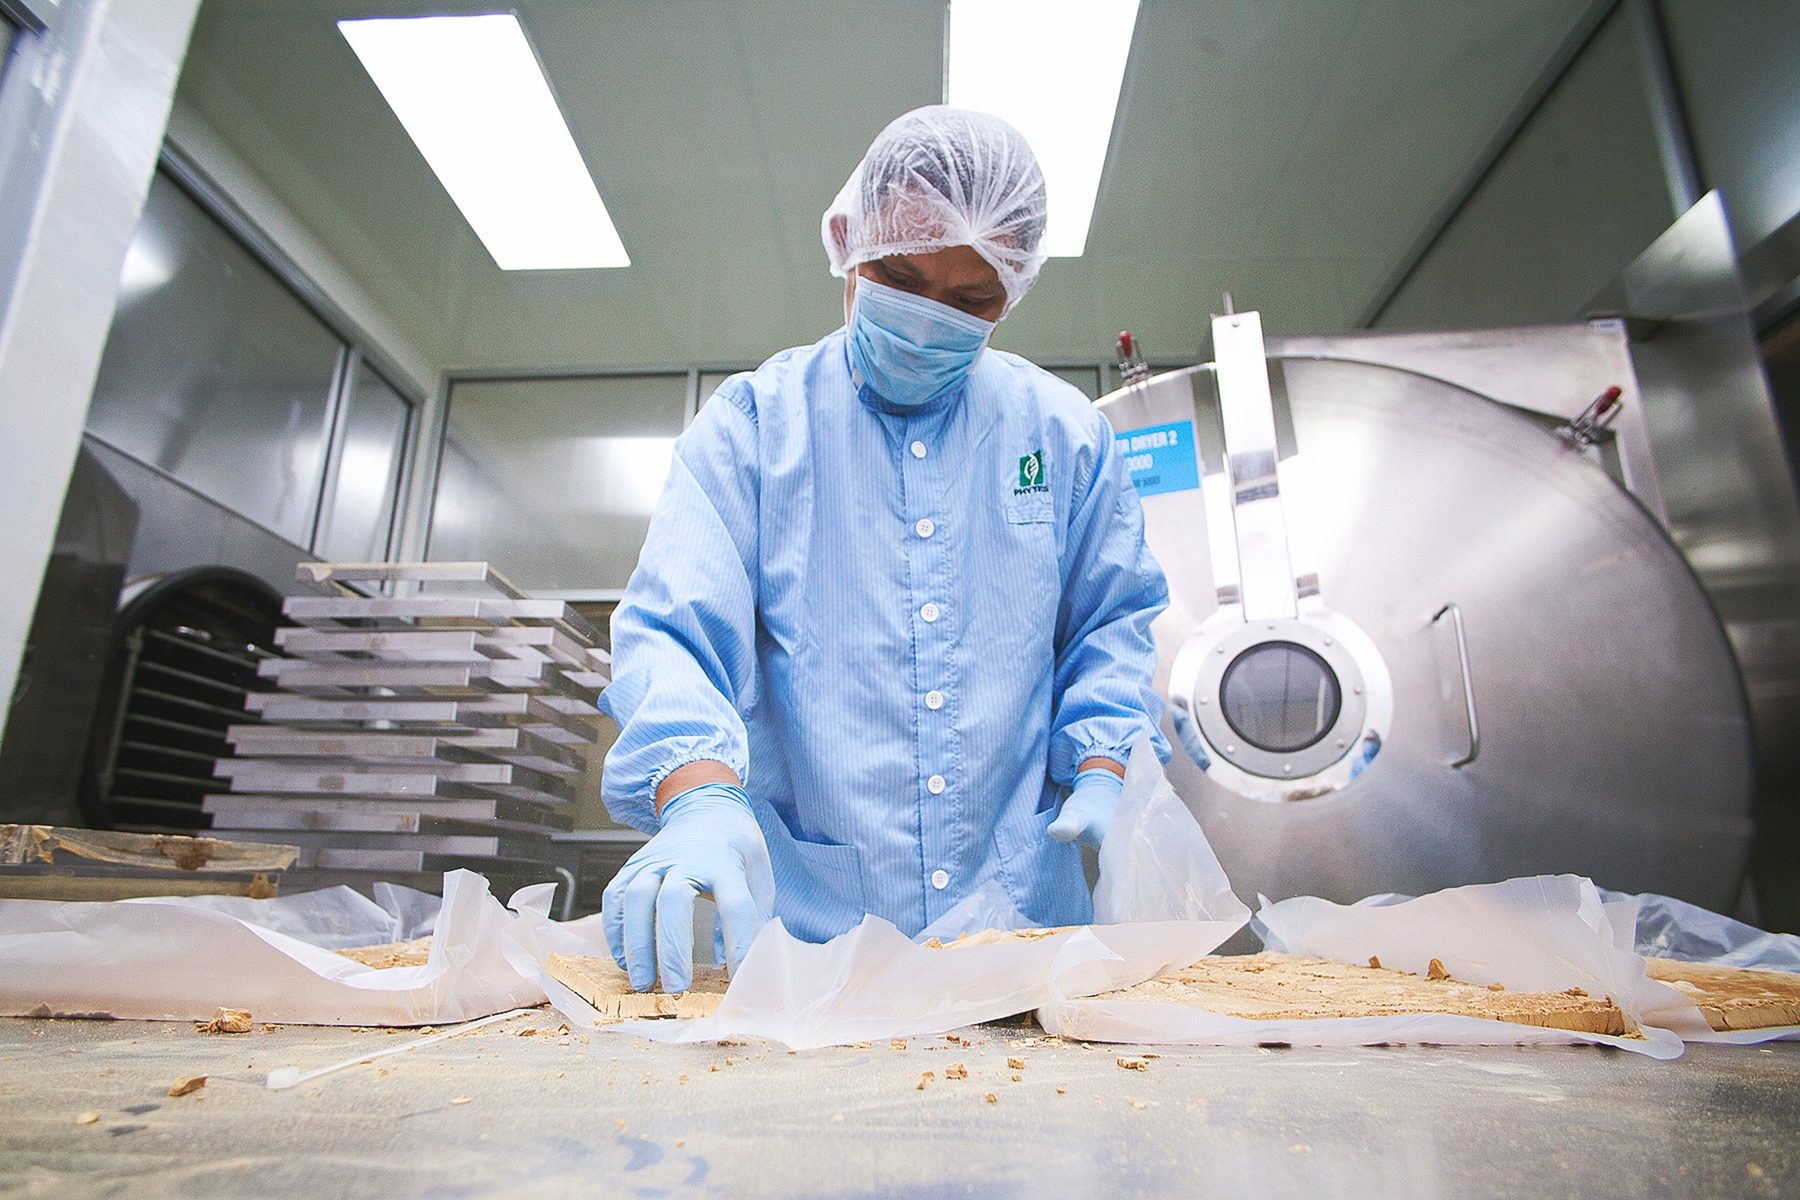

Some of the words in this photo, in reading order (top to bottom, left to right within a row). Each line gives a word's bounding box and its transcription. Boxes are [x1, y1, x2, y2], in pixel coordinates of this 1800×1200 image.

[1131, 431, 1168, 452] DRYER
[1168, 429, 1178, 446] 2
[1013, 485, 1050, 497] PHYTES
